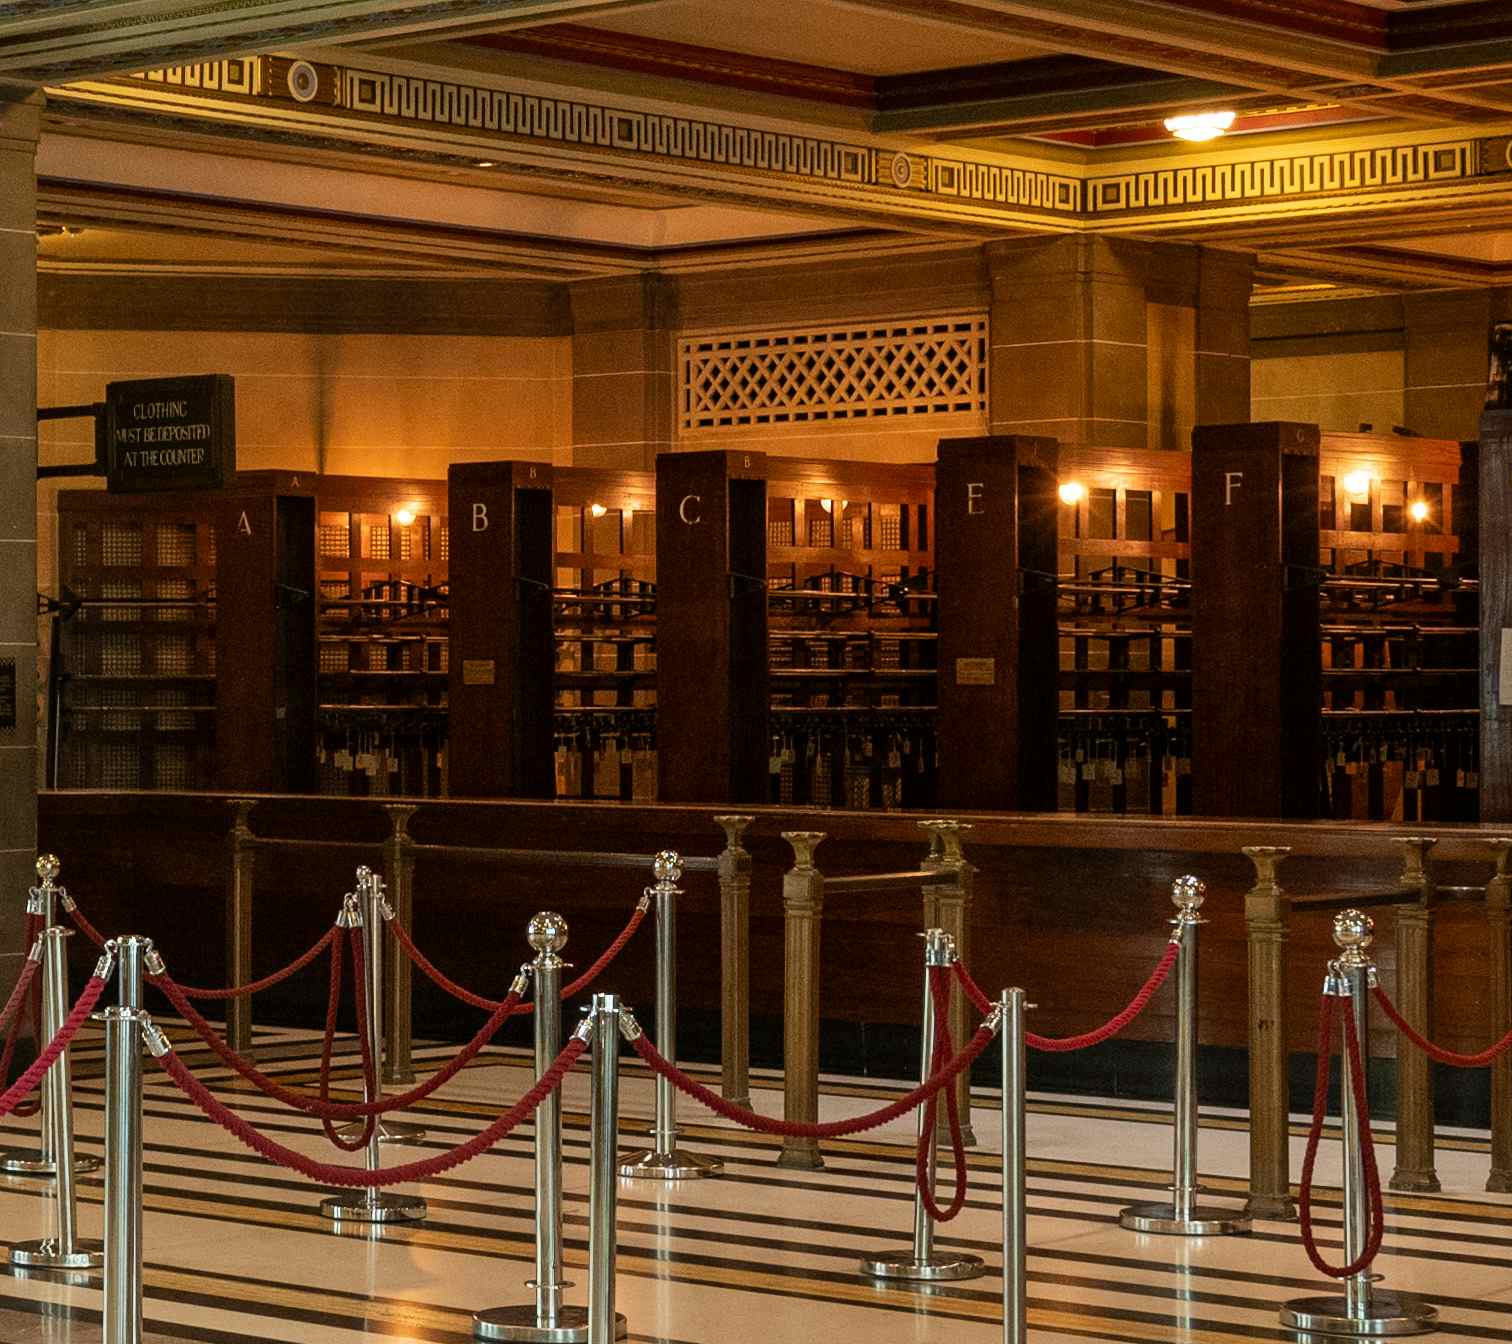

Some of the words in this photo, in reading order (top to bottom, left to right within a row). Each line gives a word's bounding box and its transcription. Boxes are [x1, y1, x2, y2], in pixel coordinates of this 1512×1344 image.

[133, 400, 187, 420] CLOTHING
[116, 427, 141, 442] MUST
[143, 426, 156, 442] BE
[157, 424, 211, 441] DEPOSITED
[124, 451, 138, 467] AT
[139, 449, 158, 467] THE
[159, 447, 205, 466] COUNTER
[966, 482, 985, 515] E
[1224, 472, 1244, 506] F
[237, 510, 253, 536] A
[472, 503, 489, 532] B
[679, 494, 702, 525] C
